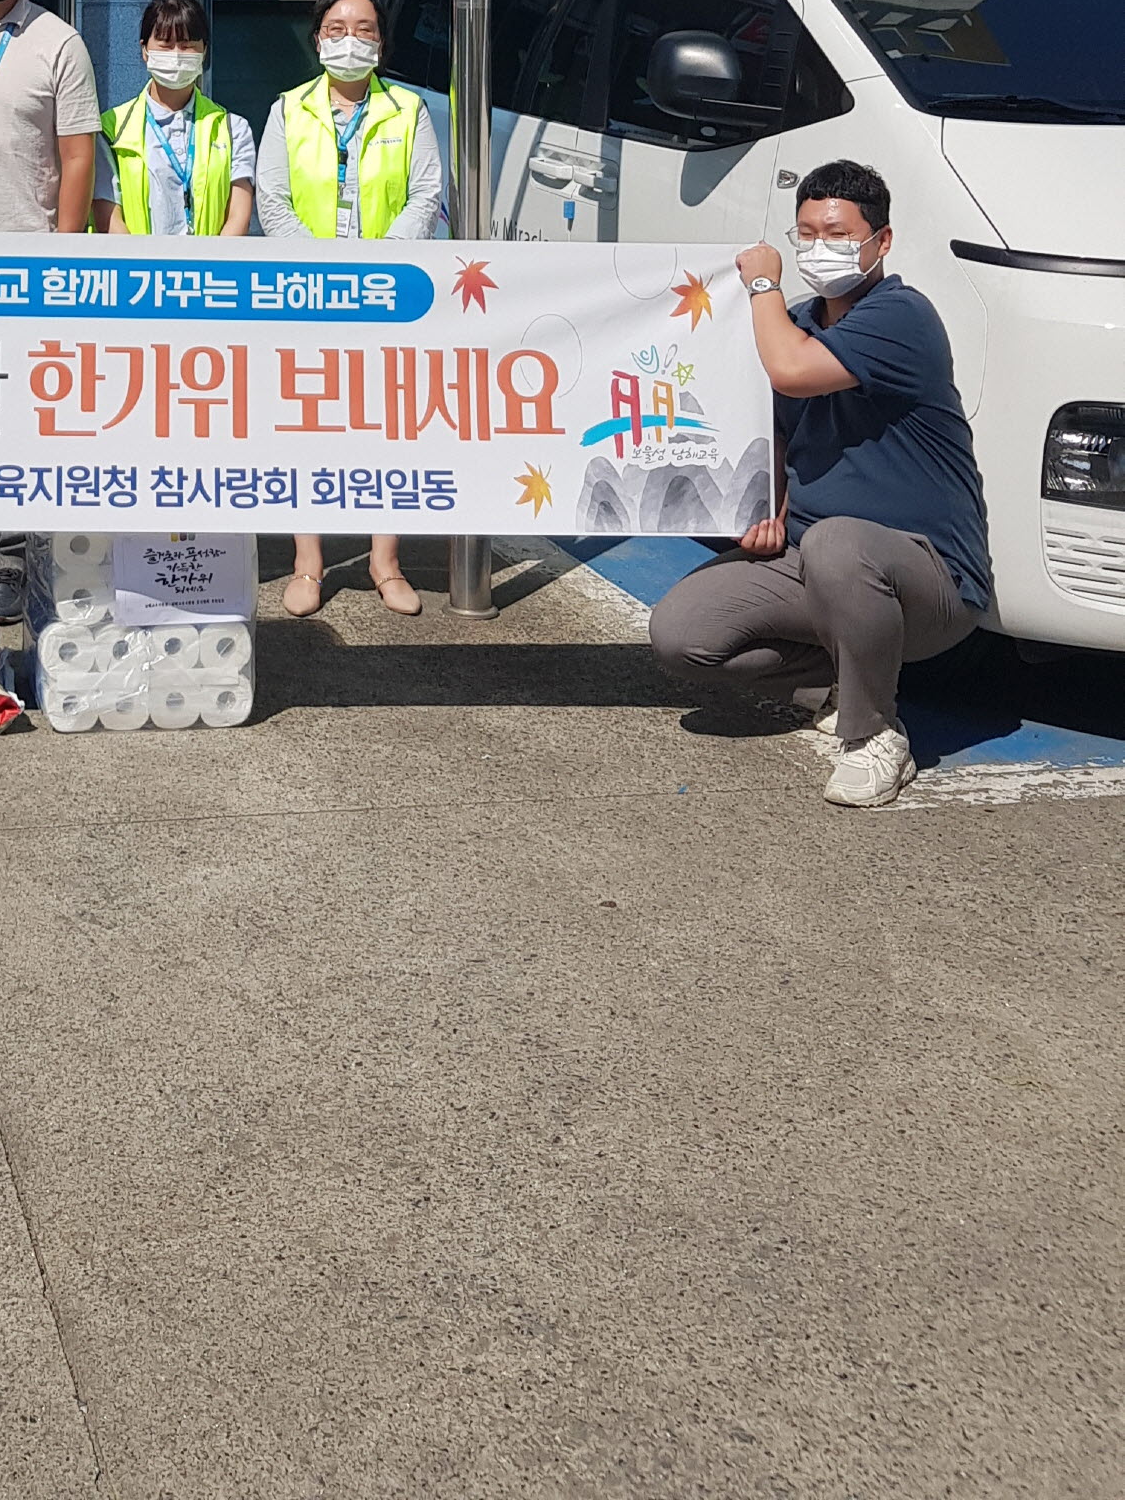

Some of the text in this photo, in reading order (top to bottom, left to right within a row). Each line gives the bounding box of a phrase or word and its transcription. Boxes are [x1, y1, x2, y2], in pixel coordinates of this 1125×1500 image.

[42, 267, 118, 307] 함께
[128, 270, 239, 308] 가꾸는
[251, 273, 397, 311] 남해교육
[27, 340, 249, 440] 한가위
[275, 347, 566, 442] 보내세요
[671, 447, 719, 462] 남해교육
[150, 466, 299, 510] 참사랑회
[311, 467, 459, 512] 회원일동
[155, 573, 213, 587] 한가위
[166, 563, 203, 572] 가득한
